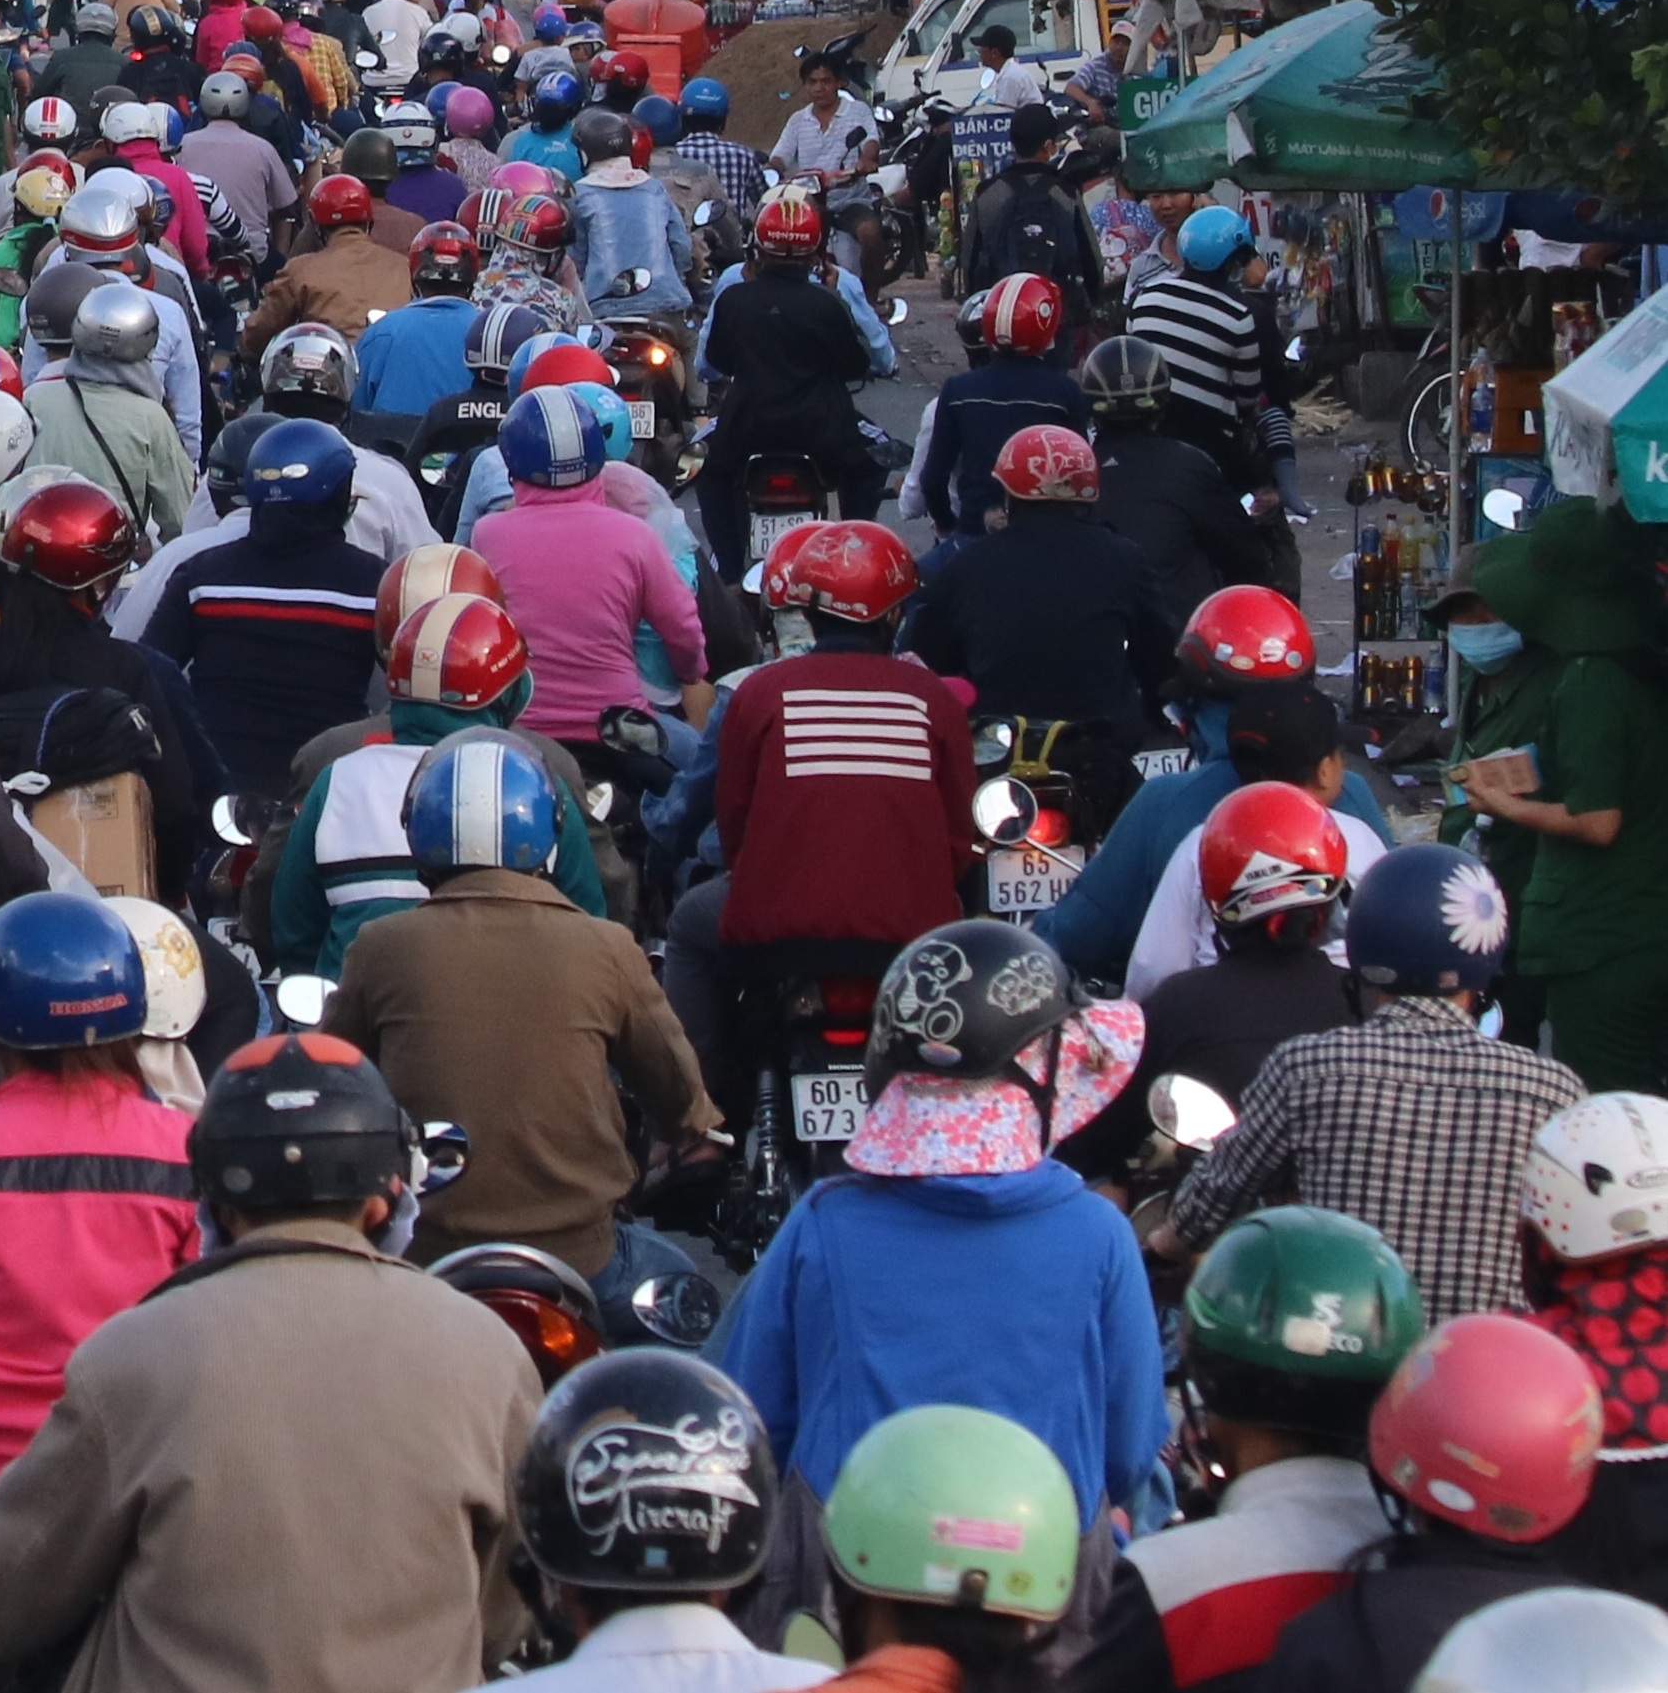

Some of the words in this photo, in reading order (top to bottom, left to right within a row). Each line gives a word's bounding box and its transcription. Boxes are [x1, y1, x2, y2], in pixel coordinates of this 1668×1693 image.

[767, 229, 811, 242] MONSTER
[457, 401, 507, 419] ENGL
[1022, 852, 1050, 877] 65
[998, 879, 1042, 907] 562
[49, 992, 129, 1016] HONDA
[801, 1110, 857, 1136] 673
